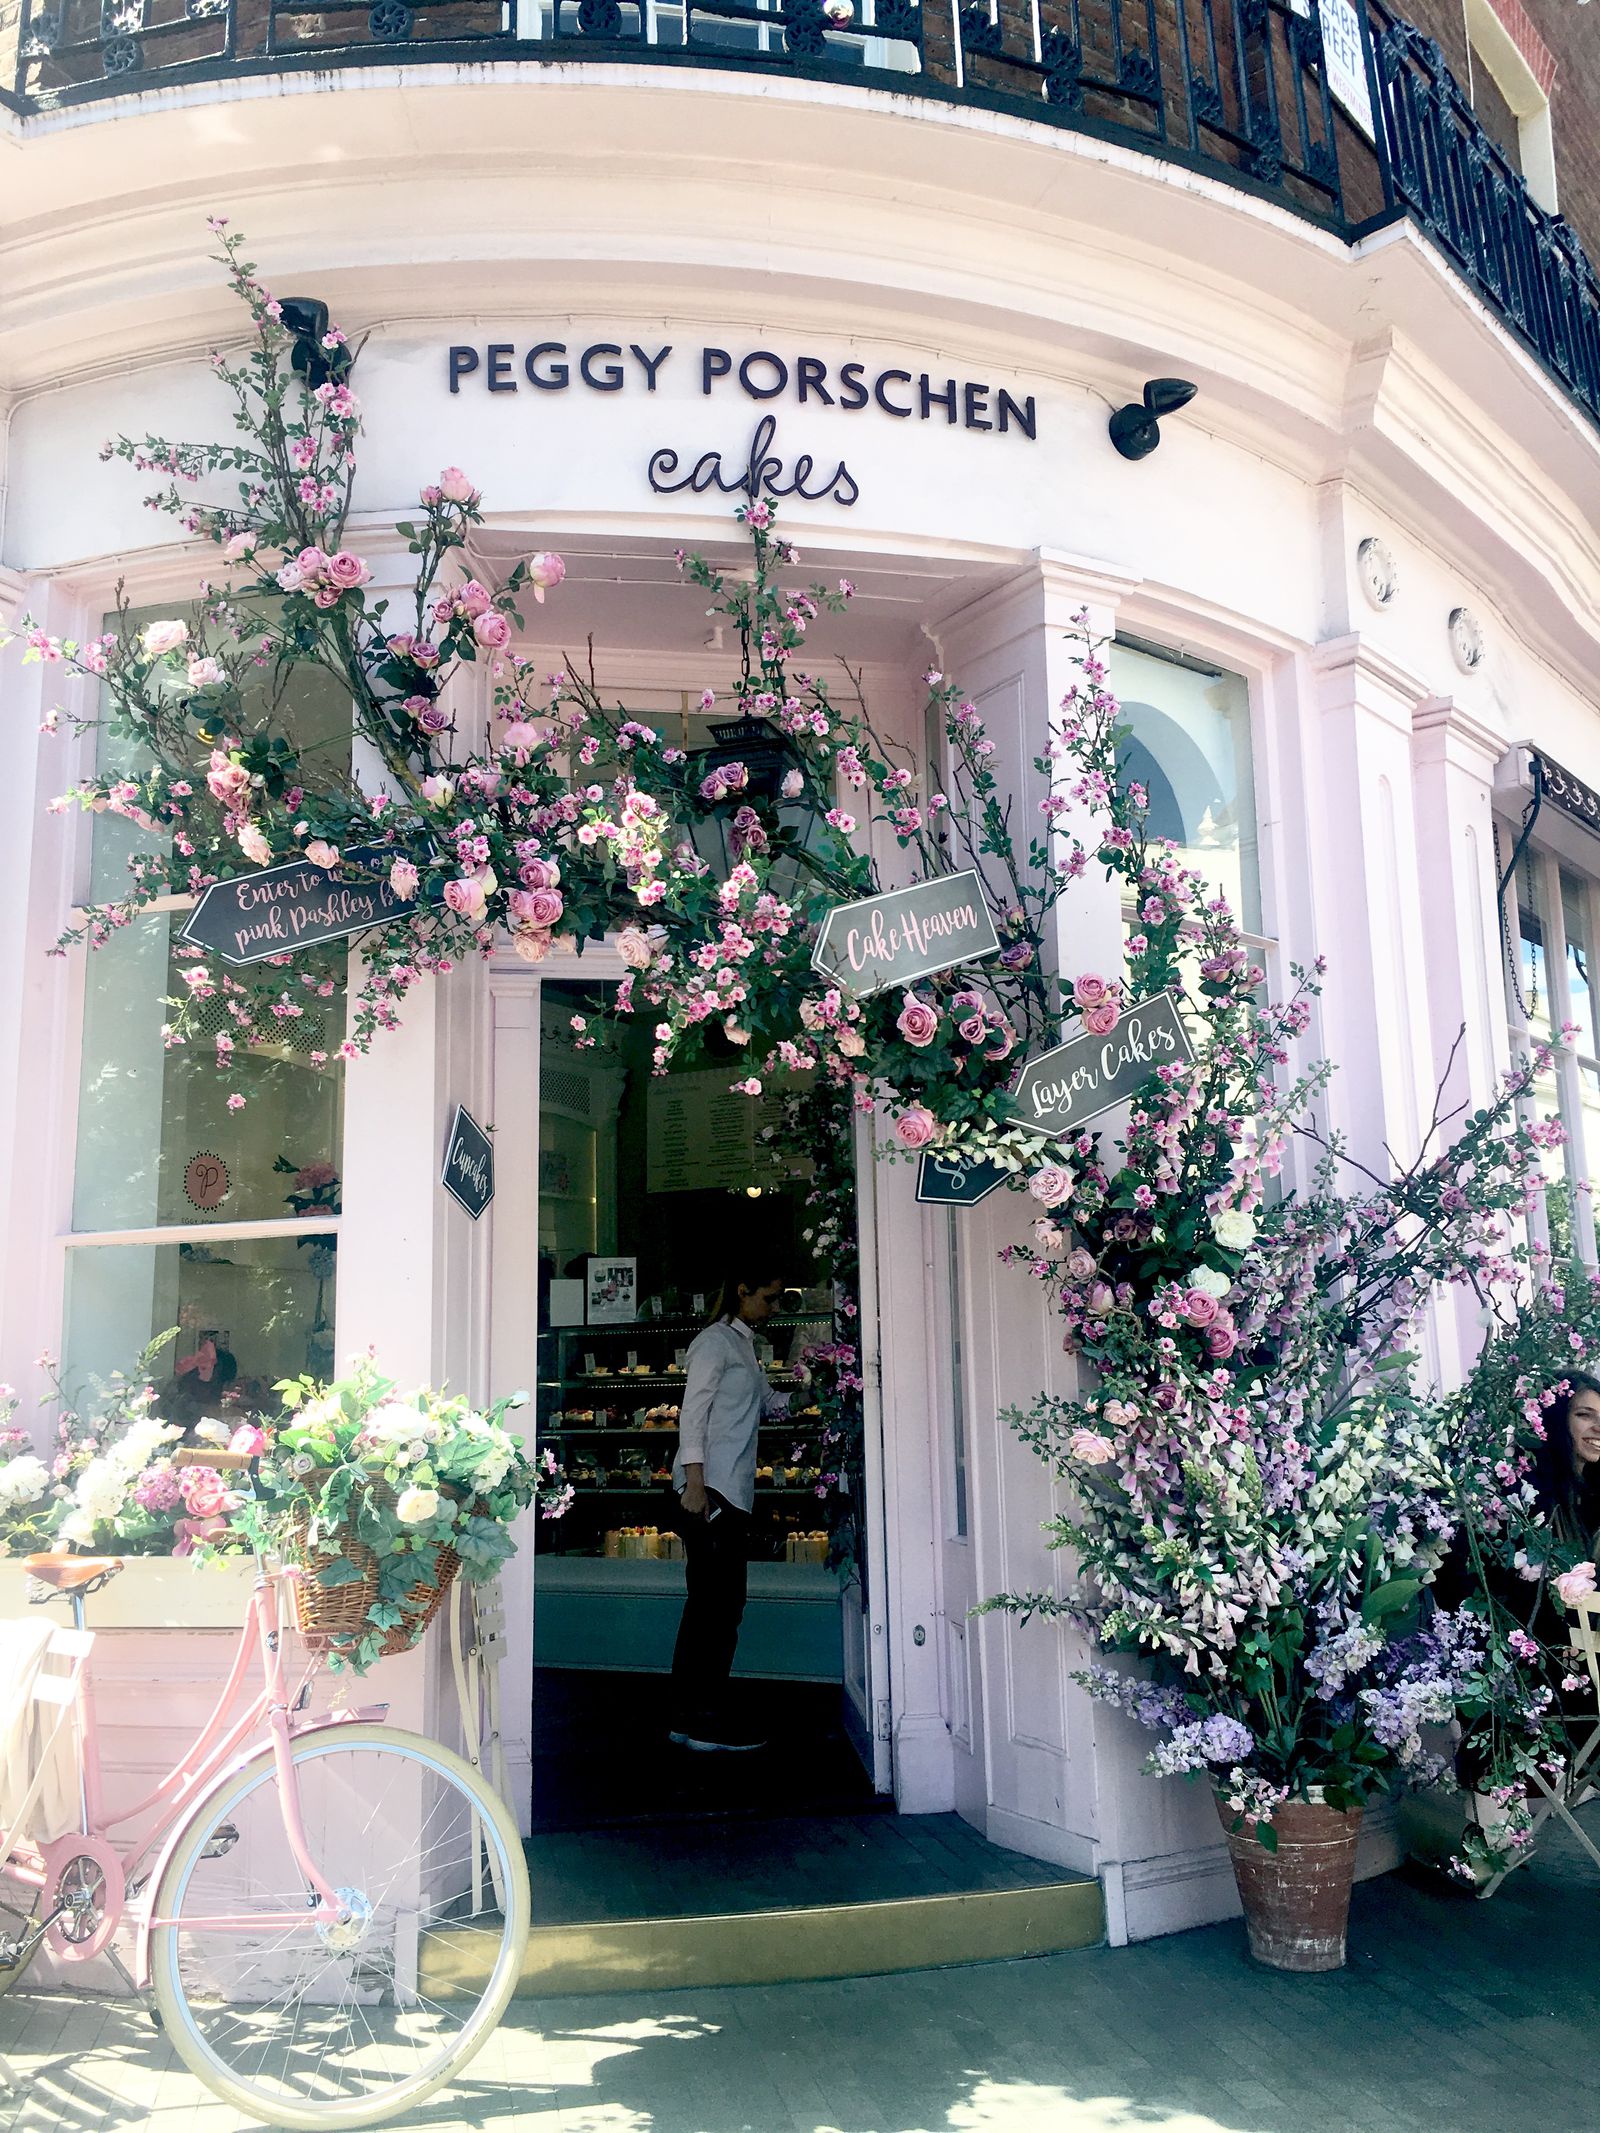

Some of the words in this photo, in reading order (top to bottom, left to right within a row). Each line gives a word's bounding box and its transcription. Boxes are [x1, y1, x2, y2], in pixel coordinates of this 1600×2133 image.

[449, 342, 672, 393] PEGGY
[702, 347, 1037, 440] PORSCHEN
[648, 415, 860, 506] cakes
[234, 905, 289, 955] pink
[289, 889, 376, 936] Pashley
[236, 880, 299, 911] Enter
[296, 871, 324, 892] to
[847, 909, 901, 971] Cake
[900, 904, 978, 956] Heaven
[1031, 1066, 1099, 1118] Layer
[1100, 1018, 1176, 1081] Cakes
[452, 1137, 488, 1201] Cupcakes
